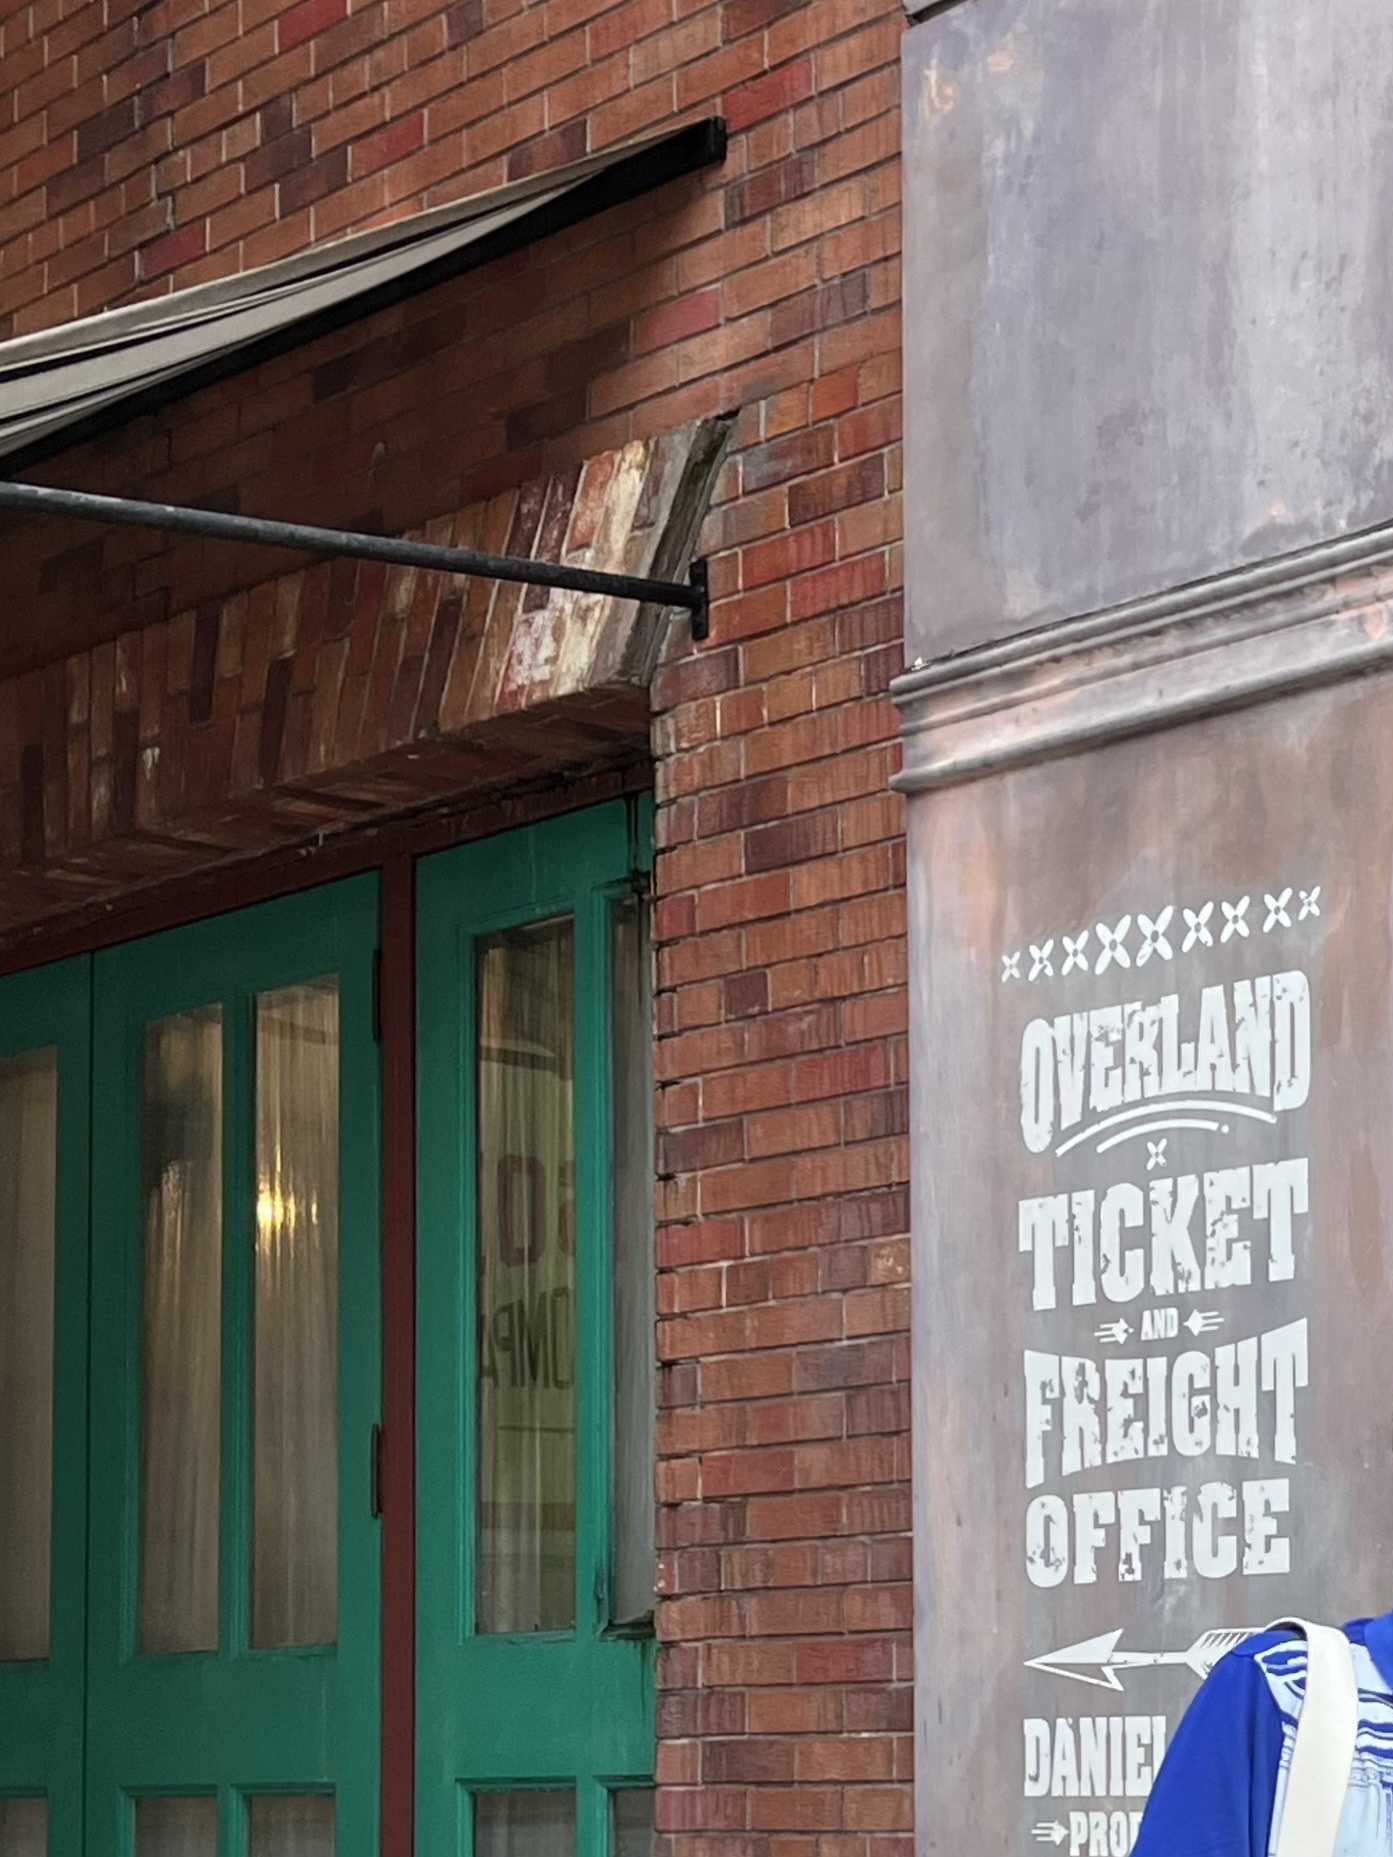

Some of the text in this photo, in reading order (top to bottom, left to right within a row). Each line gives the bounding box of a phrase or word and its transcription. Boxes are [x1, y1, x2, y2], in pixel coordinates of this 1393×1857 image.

[1020, 970, 1311, 1154] OVERLAND
[1018, 1158, 1309, 1312] TICKET
[1141, 1307, 1179, 1341] AND
[1024, 1317, 1308, 1489] FREIGHT
[1025, 1478, 1290, 1588] OFFICE
